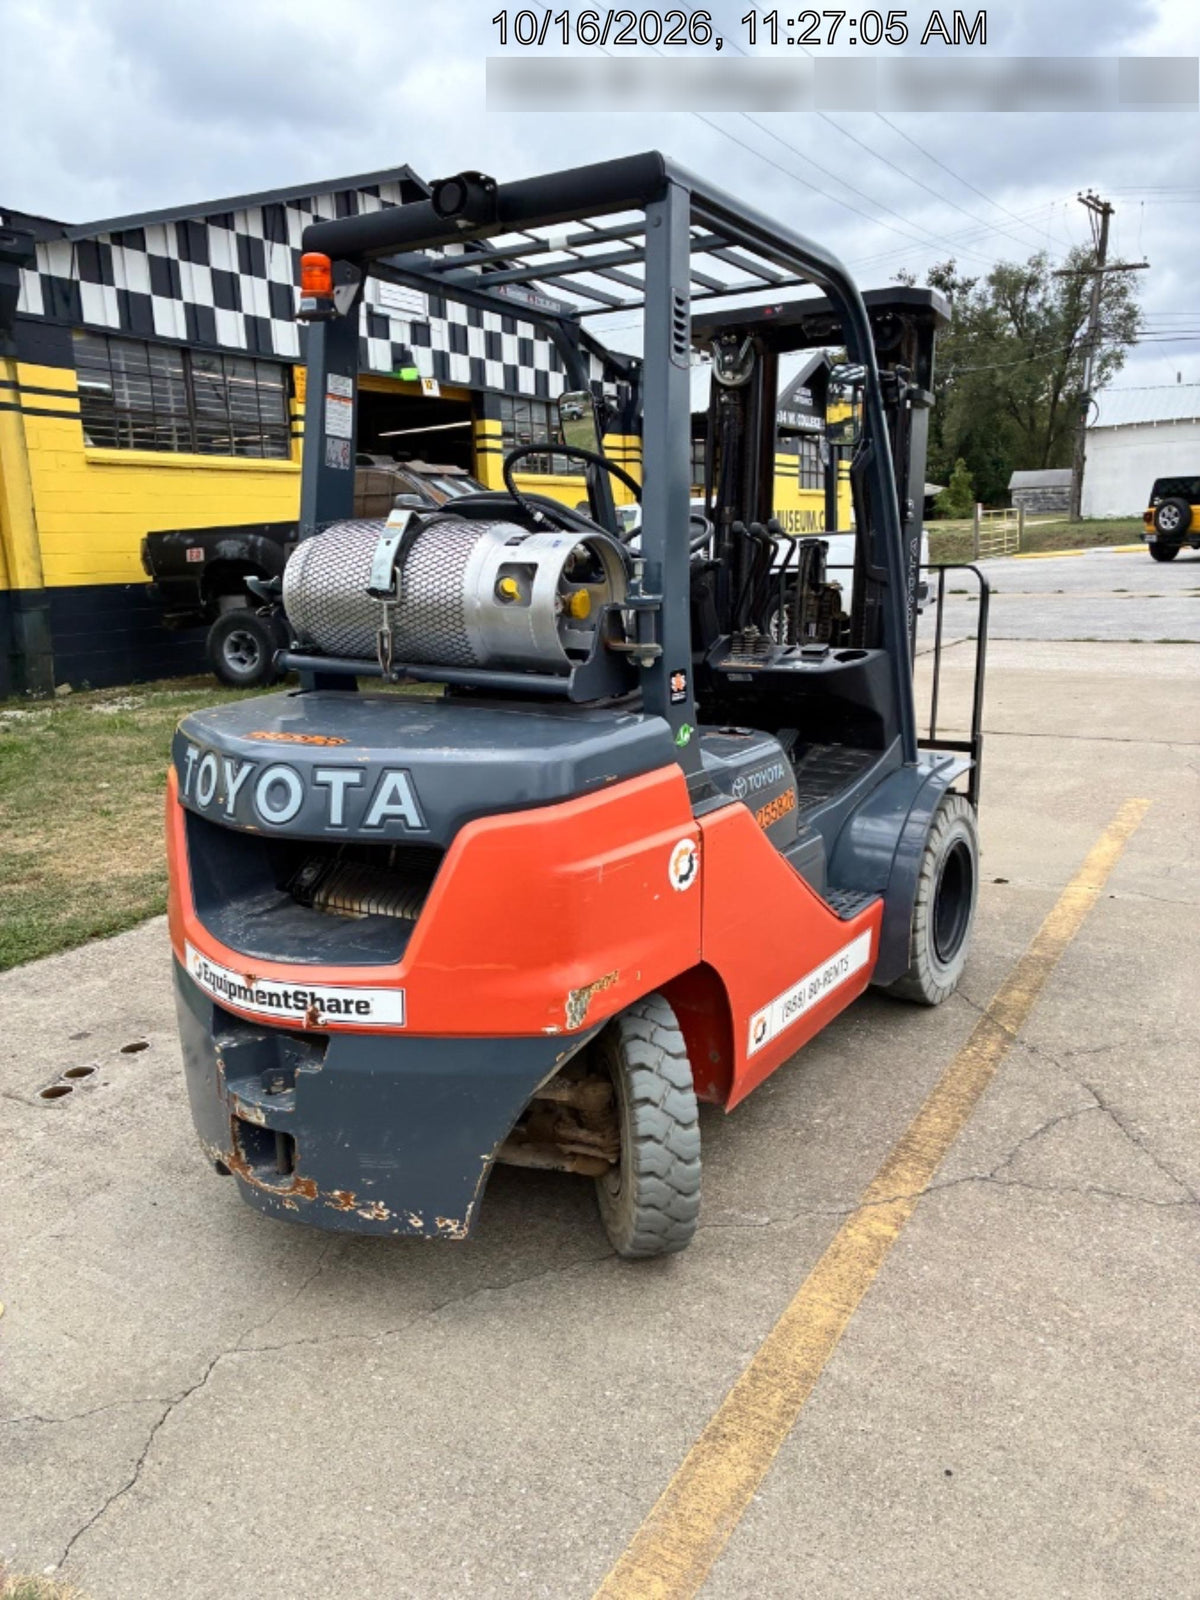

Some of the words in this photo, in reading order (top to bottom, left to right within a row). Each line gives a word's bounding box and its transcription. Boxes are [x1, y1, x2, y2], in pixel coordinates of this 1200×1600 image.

[184, 744, 425, 830] TOYOTA
[748, 764, 785, 790] TOYOTA
[203, 962, 371, 1016] EquipmentShare
[782, 988, 806, 1022] (888)
